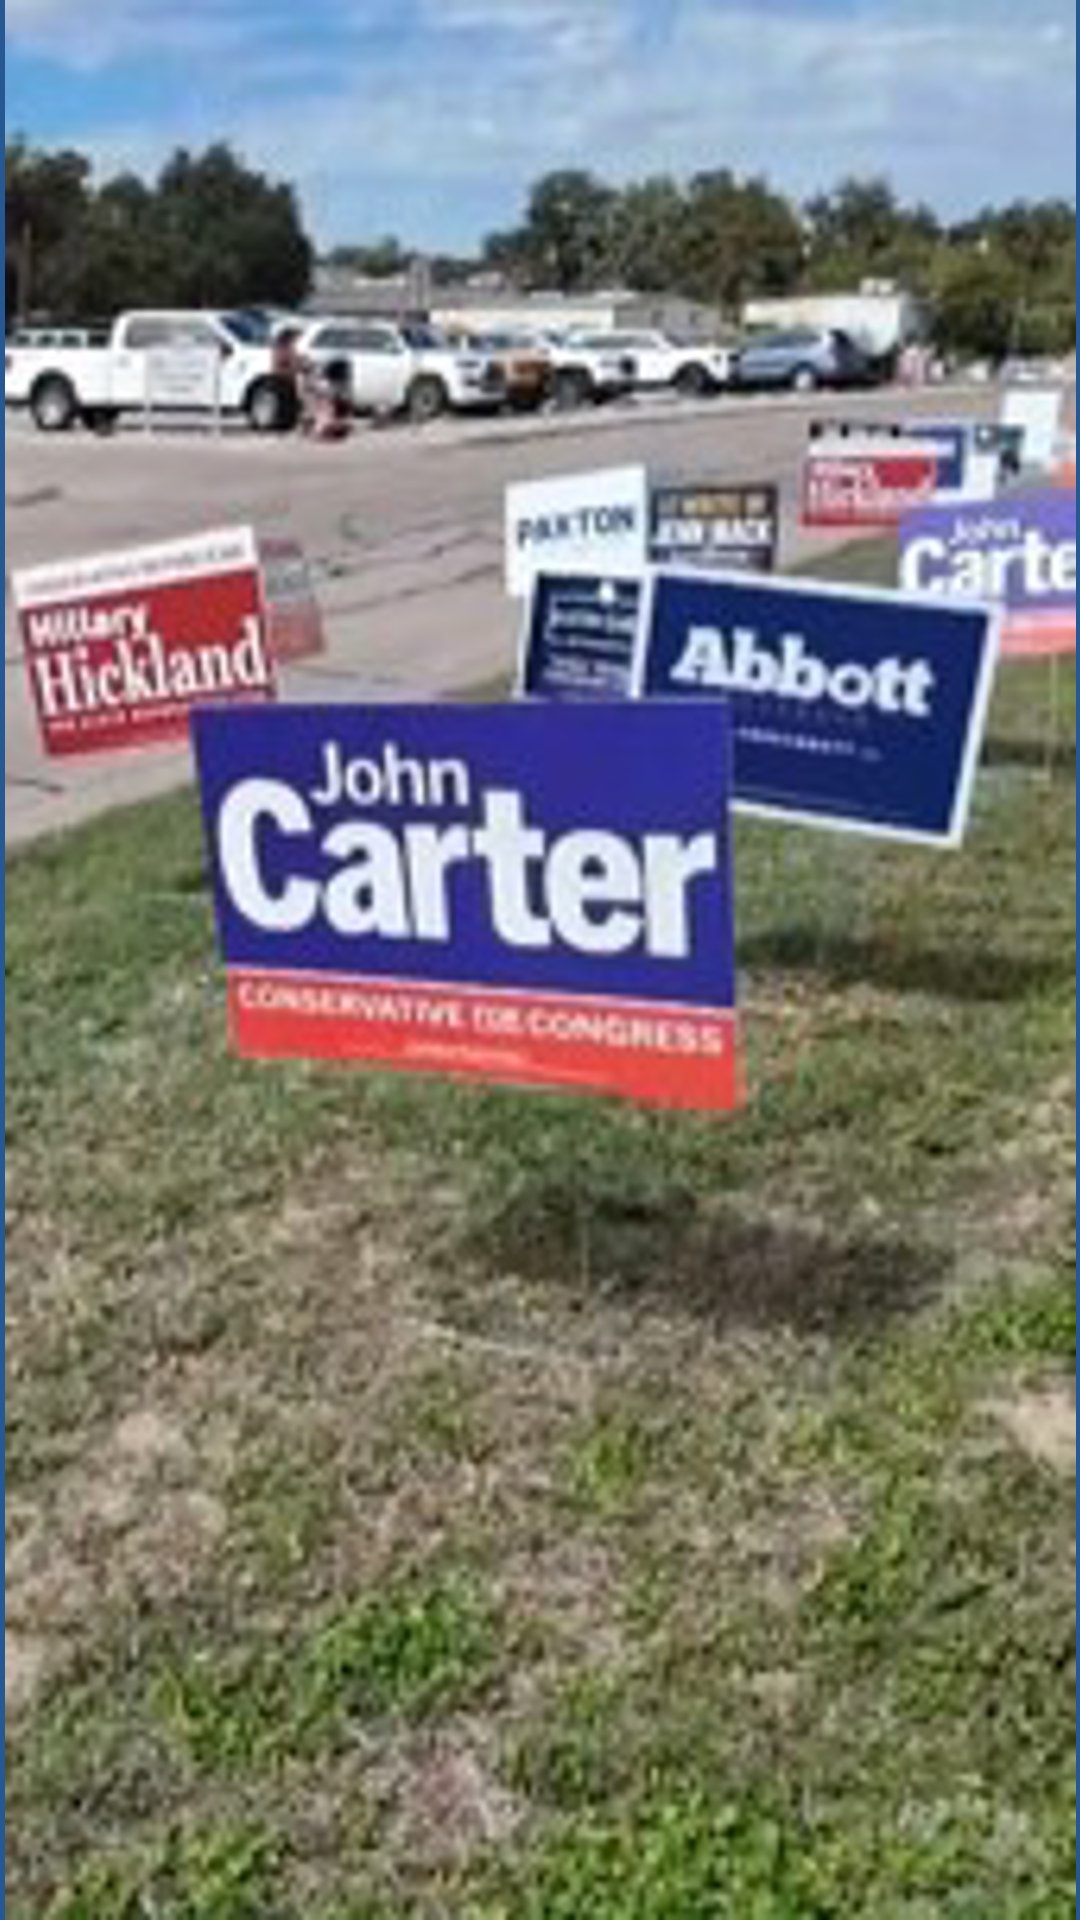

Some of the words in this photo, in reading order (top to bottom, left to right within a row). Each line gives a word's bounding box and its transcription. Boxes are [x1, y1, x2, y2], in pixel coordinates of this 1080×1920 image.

[517, 502, 636, 550] PAXTON
[950, 516, 1022, 546] John
[29, 602, 148, 647] Hillary
[34, 614, 268, 715] Hickland
[669, 626, 936, 717] Abbott
[311, 742, 470, 806] John
[218, 777, 717, 957] Carter
[237, 981, 466, 1029] CONSERVATIVE
[525, 1007, 723, 1056] CONGRESS
